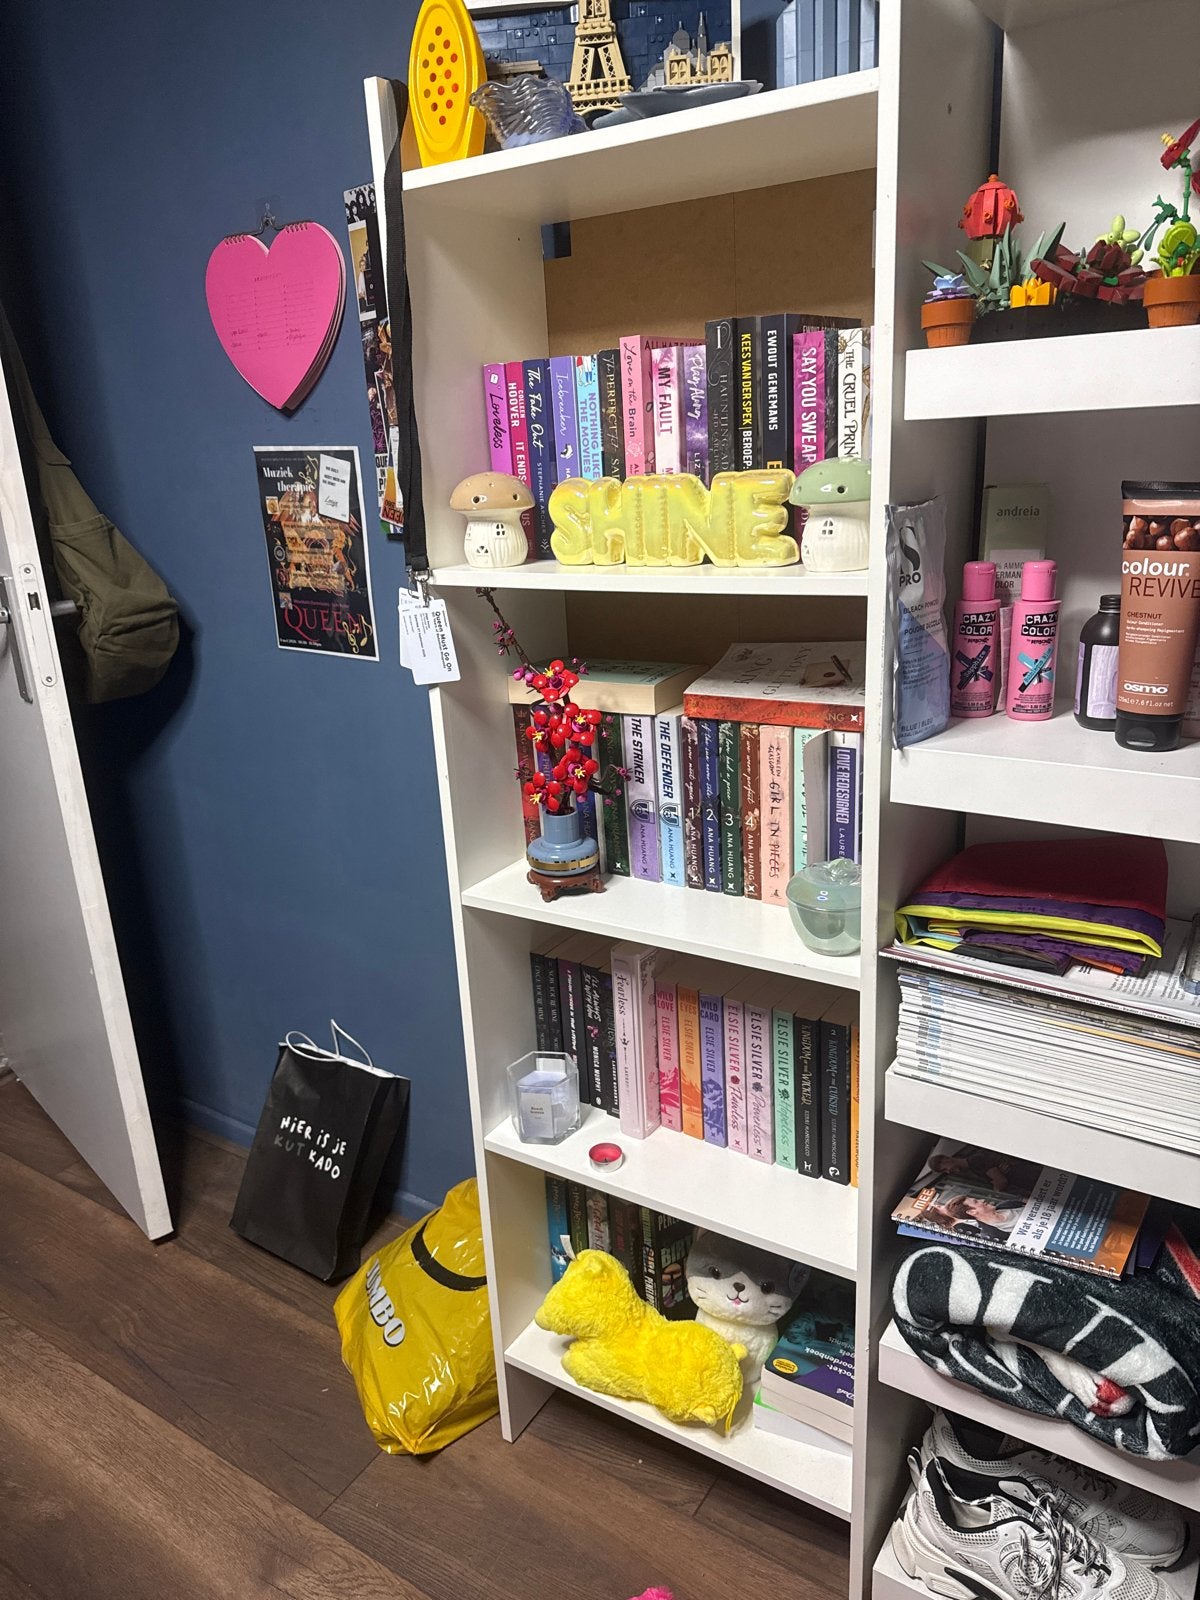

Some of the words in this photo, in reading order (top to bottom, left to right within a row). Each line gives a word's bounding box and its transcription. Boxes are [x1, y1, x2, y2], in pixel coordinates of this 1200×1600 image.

[624, 343, 636, 374] Love
[741, 334, 751, 358] KEES
[767, 330, 777, 368] EWOUT
[688, 354, 704, 385] Play
[742, 360, 751, 380] VAN
[801, 347, 816, 374] SAY
[845, 349, 855, 369] THE
[528, 368, 541, 388] The
[628, 378, 633, 387] on
[658, 368, 671, 390] MY
[801, 375, 817, 406] YOU
[508, 383, 519, 427] HOOVER
[555, 372, 568, 436] Icebreaker
[606, 374, 616, 429] PERFECT
[688, 388, 704, 419] Along
[742, 384, 751, 401] DER
[768, 370, 778, 431] GENEMANS
[843, 373, 856, 419] CRUEL
[530, 394, 541, 419] Fake
[659, 394, 672, 434] FAULT
[720, 375, 728, 446] HAUNTING
[743, 402, 751, 425] SPEK
[490, 393, 507, 448] Loveless
[588, 393, 600, 449] NOTHING
[516, 442, 524, 450] IT
[533, 424, 544, 456] Out
[581, 427, 590, 472] MOVIES
[743, 431, 753, 469] BEROEP:
[801, 412, 817, 464] SWEAR
[839, 420, 858, 456] PRIN
[262, 466, 293, 478] Muziek
[517, 456, 526, 480] ENDS
[277, 481, 314, 494] therapie
[536, 462, 545, 502] STEPHANIE
[522, 513, 530, 526] US
[548, 469, 800, 567] SHINE
[997, 505, 1040, 517] andreia
[900, 572, 921, 587] PRO
[995, 571, 1022, 580] ERMAN
[1130, 577, 1200, 598] REVIVE
[434, 610, 443, 631] Queen
[903, 605, 923, 614] BLEACH
[963, 612, 996, 623] CRAZY
[1026, 613, 1058, 624] CRAZY
[284, 604, 362, 642] QUEEN
[904, 624, 925, 635] POUDRE
[960, 625, 993, 635] COLOR
[1022, 626, 1056, 636] COLOR
[443, 652, 450, 661] Go
[446, 662, 452, 671] On
[1124, 682, 1168, 694] osmo
[631, 718, 642, 737] THE
[659, 721, 670, 739] THE
[901, 723, 917, 732] BLUE
[632, 740, 645, 784] STRIKER
[660, 742, 674, 798] DEFENDER
[726, 756, 735, 771] had
[836, 748, 850, 772] LOVE
[722, 781, 732, 800] price
[743, 774, 755, 804] perfect
[769, 781, 780, 814] GIRL
[835, 773, 850, 824] REDESIGNED
[726, 813, 734, 826] 3
[746, 816, 755, 828] 4
[769, 821, 780, 837] IN
[769, 844, 780, 878] PIECES
[591, 990, 602, 1022] ALWAYS
[615, 974, 630, 1016] Fearless
[657, 990, 674, 1001] WILD
[657, 1001, 674, 1012] LOVE
[700, 1000, 718, 1012] WILD
[661, 1016, 671, 1037] ELSIE
[700, 1011, 719, 1022] CARD
[728, 1005, 739, 1034] ELSIE
[751, 1012, 762, 1041] ELSIE
[684, 1019, 693, 1040] ELSIE
[705, 1027, 714, 1046] ELSIE
[777, 1017, 789, 1046] ELSIE
[662, 1038, 672, 1061] SILVER
[685, 1042, 695, 1065] SILVER
[728, 1036, 740, 1072] SILVER
[798, 1025, 812, 1060] KINGDOM
[706, 1048, 716, 1073] SILVER
[751, 1043, 763, 1080] SILVER
[778, 1049, 790, 1086] SILVER
[826, 1040, 838, 1073] KINGDOM
[800, 1072, 812, 1106] WICKED
[828, 1086, 838, 1115] CURSED
[728, 1085, 743, 1130] Flawless
[753, 1093, 766, 1150] Powerless
[779, 1098, 794, 1146] Hopeless
[274, 1134, 306, 1158] KUT
[308, 1151, 341, 1180] KADO
[1052, 1172, 1069, 1198] wordt?
[914, 1188, 933, 1209] MEE
[1045, 1197, 1060, 1212] jaar
[1016, 1221, 1032, 1237] Wat
[1026, 1186, 1049, 1222] verandert
[1040, 1211, 1050, 1220] 18
[1030, 1227, 1044, 1240] als
[365, 1258, 406, 1348] JUMBO
